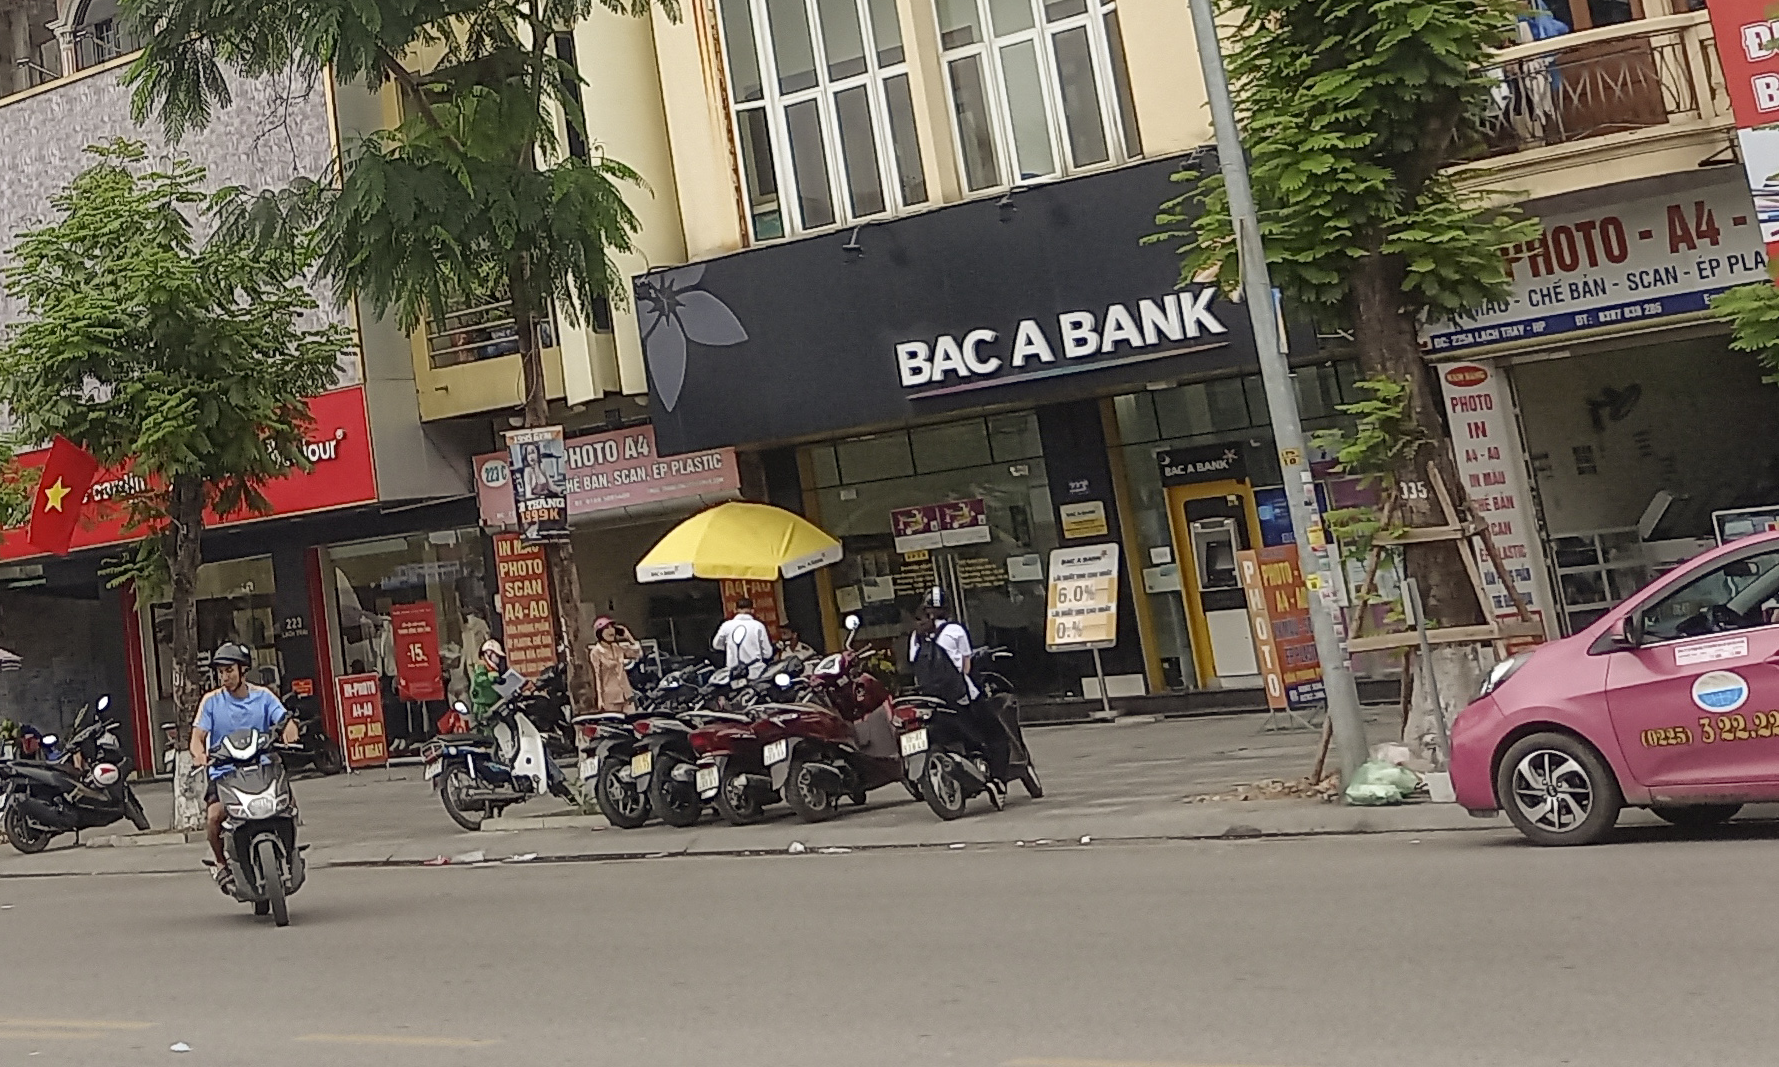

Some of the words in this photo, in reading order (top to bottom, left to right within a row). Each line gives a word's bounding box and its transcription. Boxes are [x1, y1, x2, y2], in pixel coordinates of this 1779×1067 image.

[1498, 215, 1630, 282] PHOTO
[1665, 199, 1721, 255] A4
[1528, 278, 1565, 309] CHẾ
[1570, 273, 1607, 301] BẢN
[1626, 264, 1678, 292] SCAN
[1697, 254, 1721, 280] ÉP
[895, 328, 1003, 388] BAC
[1011, 319, 1056, 367] A
[1058, 286, 1229, 359] BANK
[1450, 393, 1493, 414] PHOTO
[1466, 420, 1488, 439] IN
[623, 434, 650, 459] A4
[566, 476, 581, 495] HẾ
[653, 460, 668, 479] ÉP
[671, 454, 722, 476] PLASTIC
[1164, 464, 1186, 477] BAC
[1187, 463, 1195, 474] A
[1195, 458, 1229, 473] BANK
[1488, 520, 1513, 538] CAN
[498, 540, 511, 557] IN
[499, 557, 544, 579] PHOTO
[505, 579, 543, 598] SCAN
[1058, 583, 1096, 604] 6.0%
[504, 599, 550, 622] A4-A0
[285, 616, 304, 631] 223
[1242, 560, 1282, 698] PHOTO
[1640, 725, 1694, 749] (0225)
